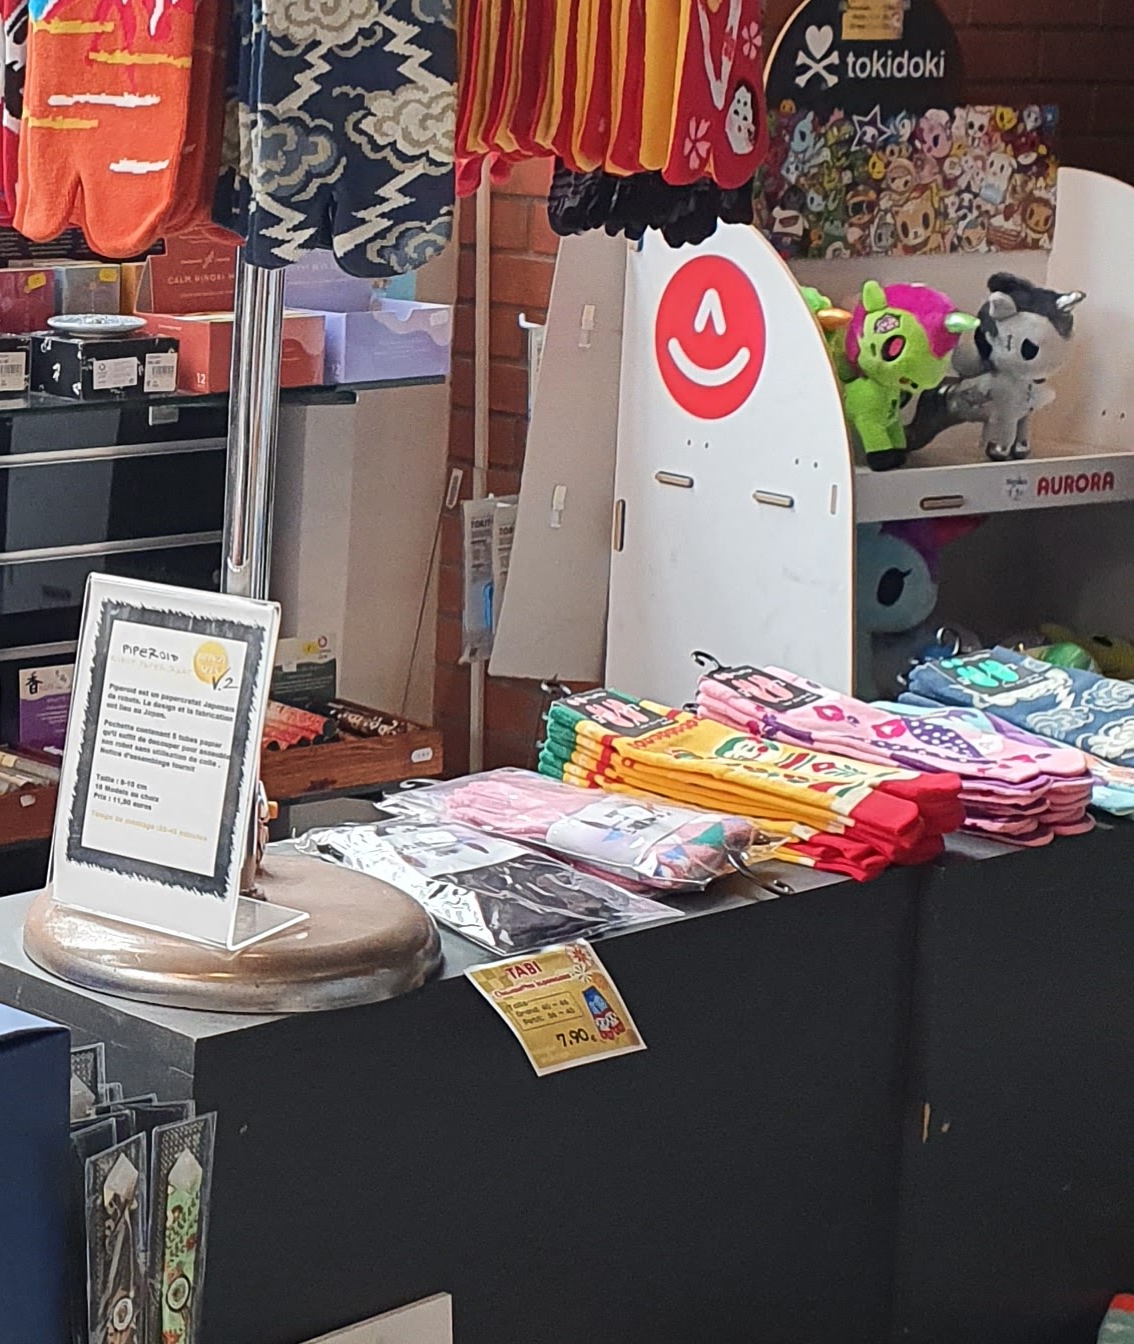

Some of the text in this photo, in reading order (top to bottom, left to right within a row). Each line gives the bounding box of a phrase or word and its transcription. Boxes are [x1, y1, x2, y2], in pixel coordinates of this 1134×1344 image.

[847, 49, 945, 78] tokidoki
[1037, 471, 1115, 496] AURORA
[109, 683, 137, 697] Piperoid
[138, 688, 149, 697] est
[505, 961, 542, 979] TABI
